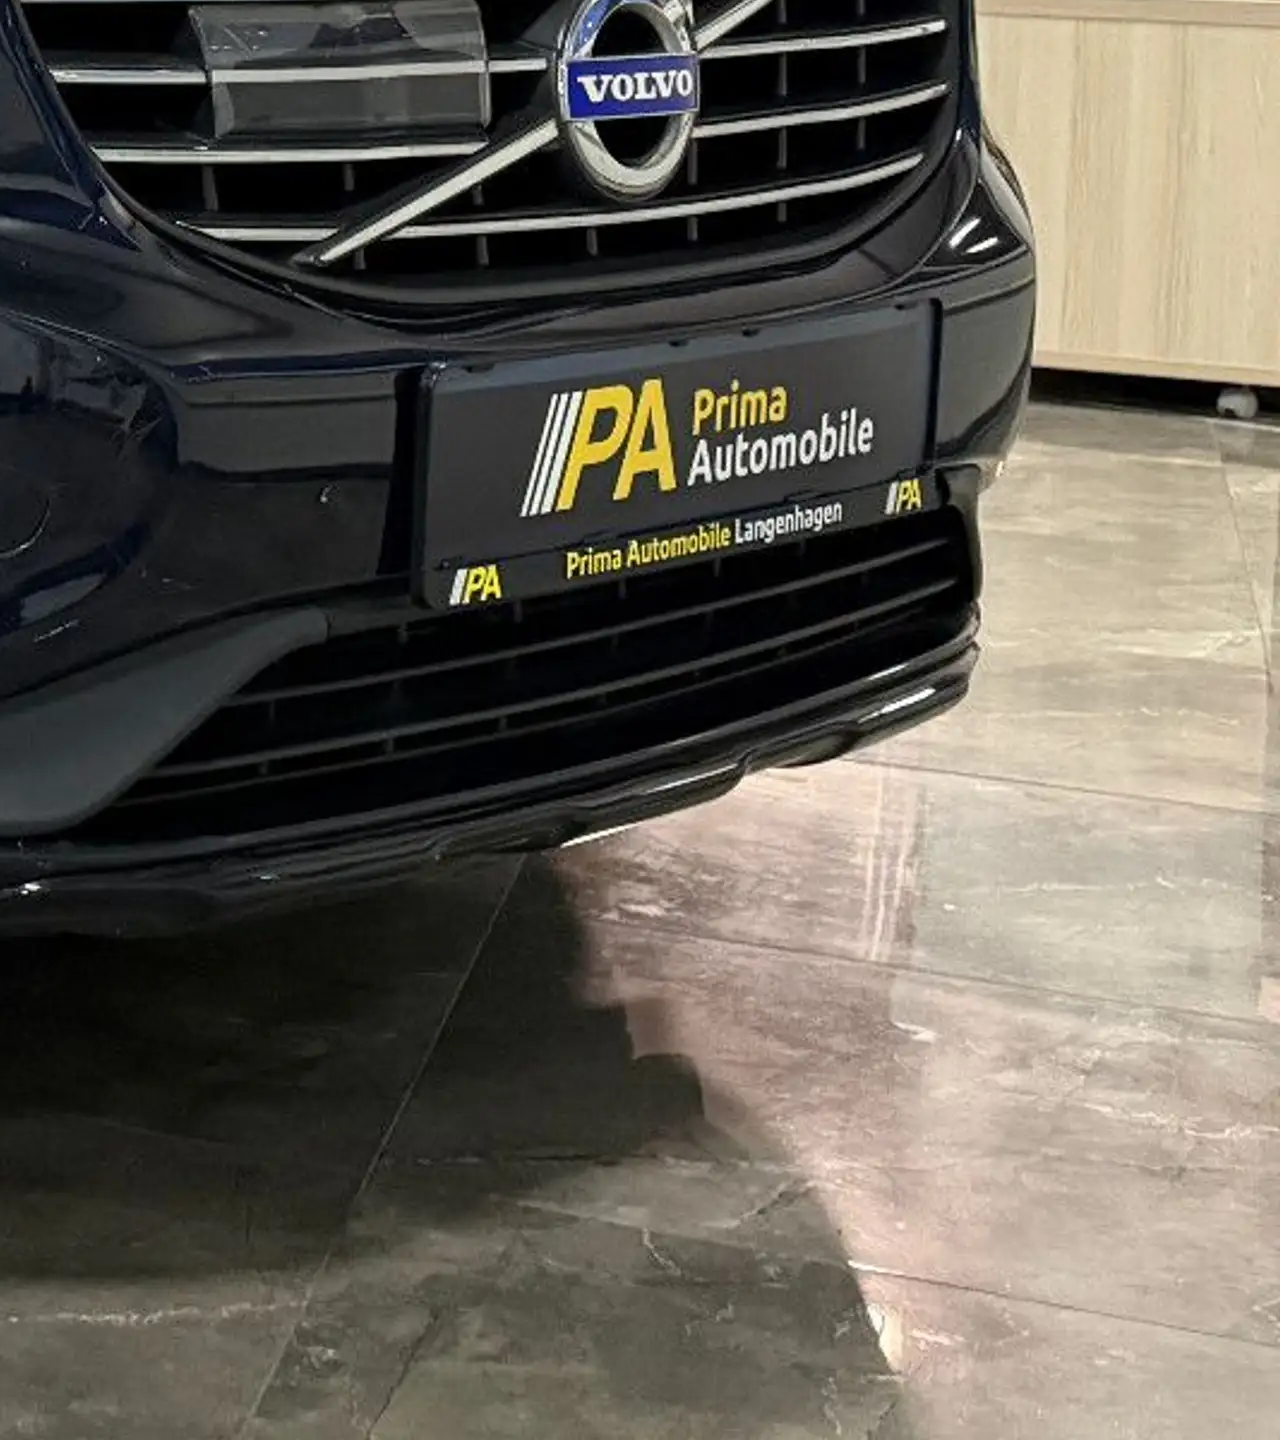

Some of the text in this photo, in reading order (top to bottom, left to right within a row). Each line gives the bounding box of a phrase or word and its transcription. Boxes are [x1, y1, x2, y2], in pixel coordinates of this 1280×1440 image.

[577, 70, 693, 103] VOLVO
[692, 379, 788, 436] Prima
[687, 408, 874, 487] Automobile
[566, 501, 843, 580] Prima Automobile Langenhagen
